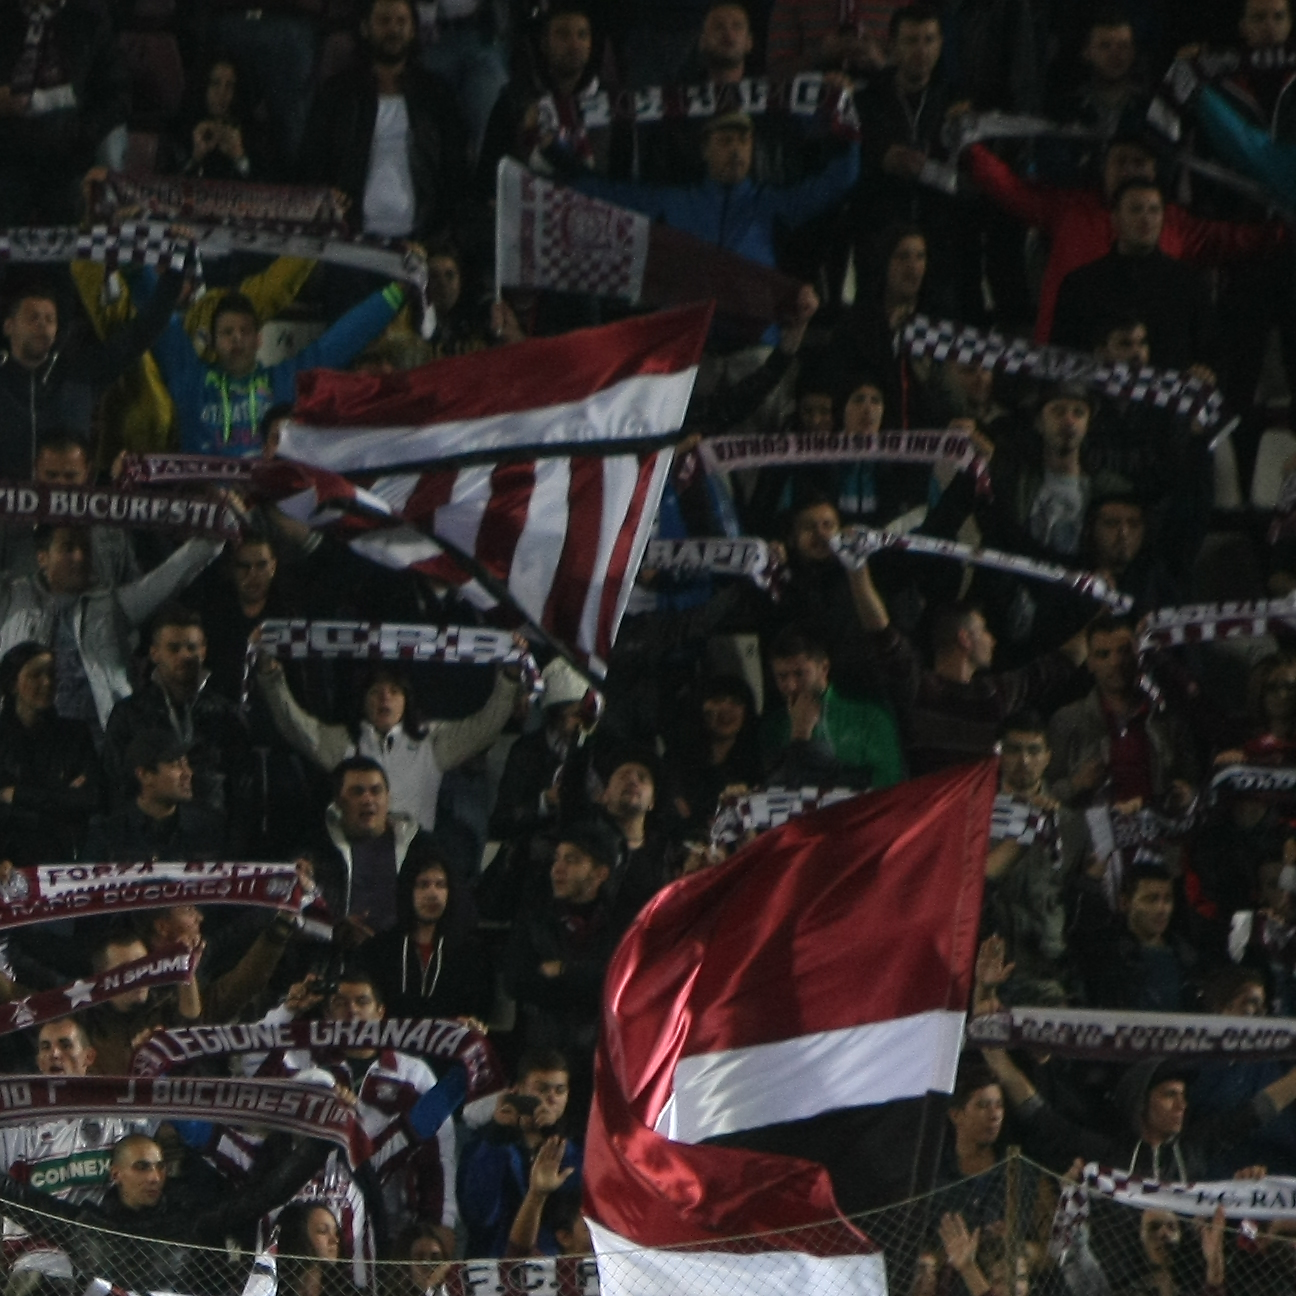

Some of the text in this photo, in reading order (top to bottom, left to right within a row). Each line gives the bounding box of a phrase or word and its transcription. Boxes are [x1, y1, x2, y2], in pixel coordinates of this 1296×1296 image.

[48, 487, 222, 531] BUCURESTI
[120, 954, 190, 985] SPUME
[161, 1016, 472, 1065] LEGIONE GRANATA
[153, 1079, 331, 1123] BUCURESTI
